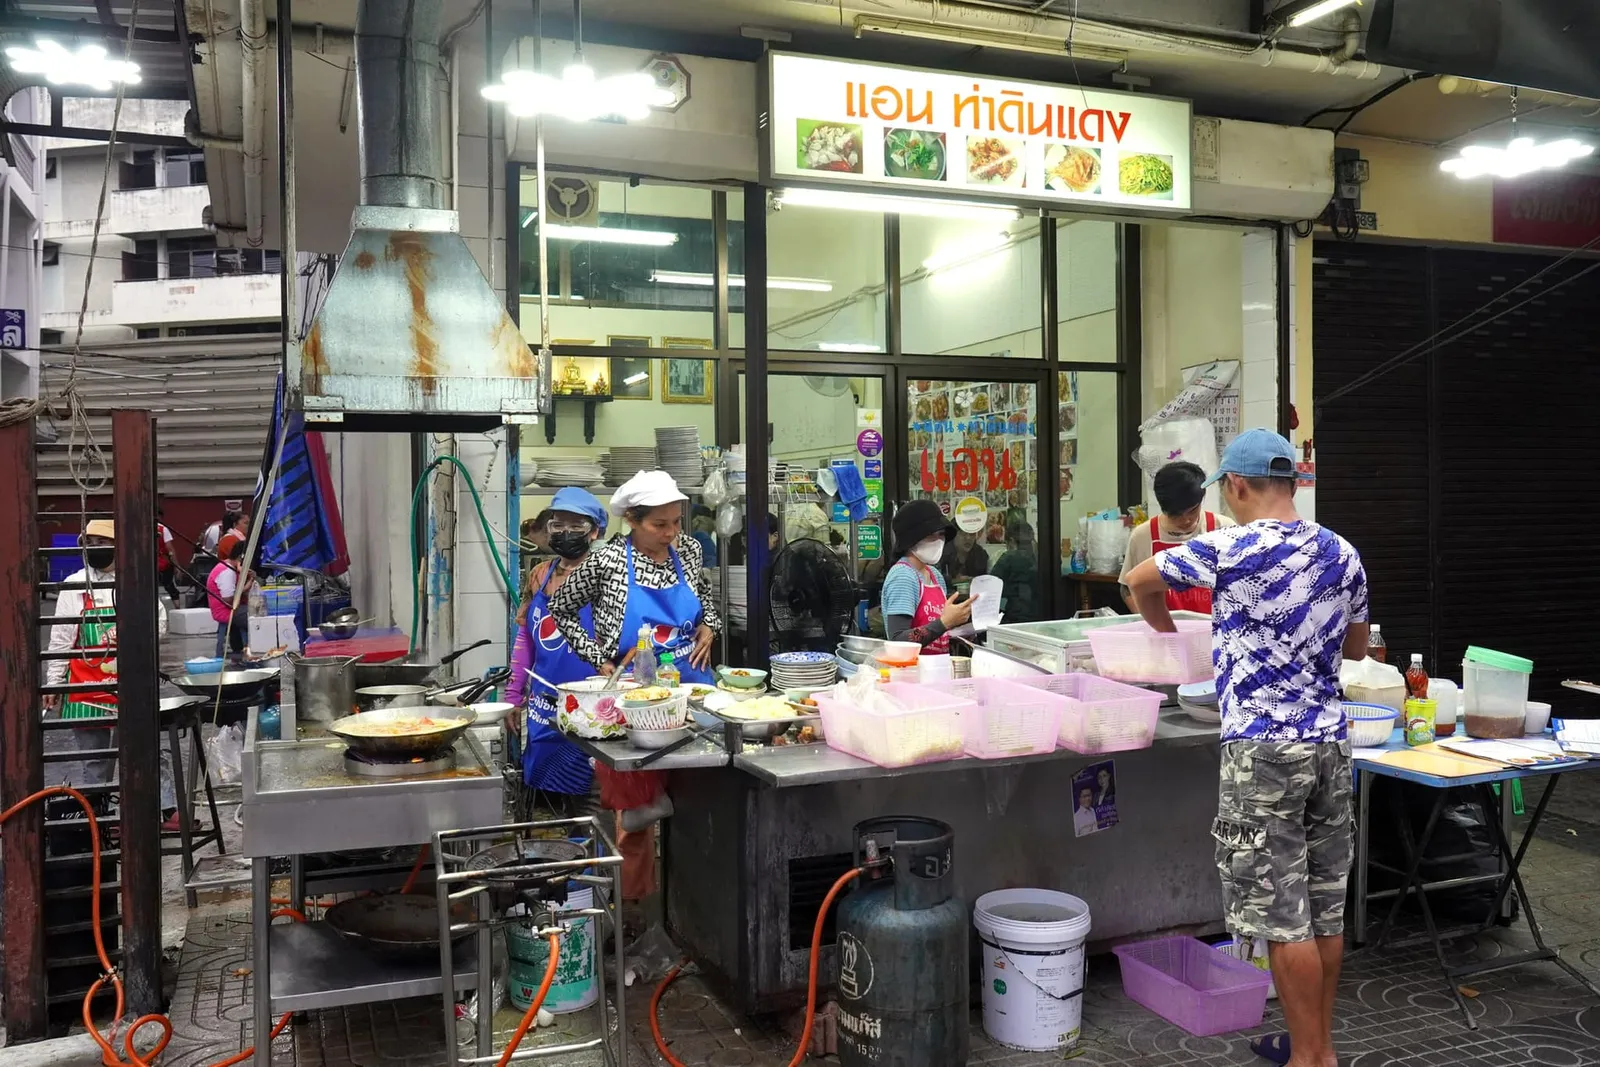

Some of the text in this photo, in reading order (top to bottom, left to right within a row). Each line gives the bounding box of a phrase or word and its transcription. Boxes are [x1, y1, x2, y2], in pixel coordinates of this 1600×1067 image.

[846, 82, 1132, 144] แอน ท่าดินแดง
[920, 447, 1017, 492] แอน
[857, 1043, 867, 1056] 15
